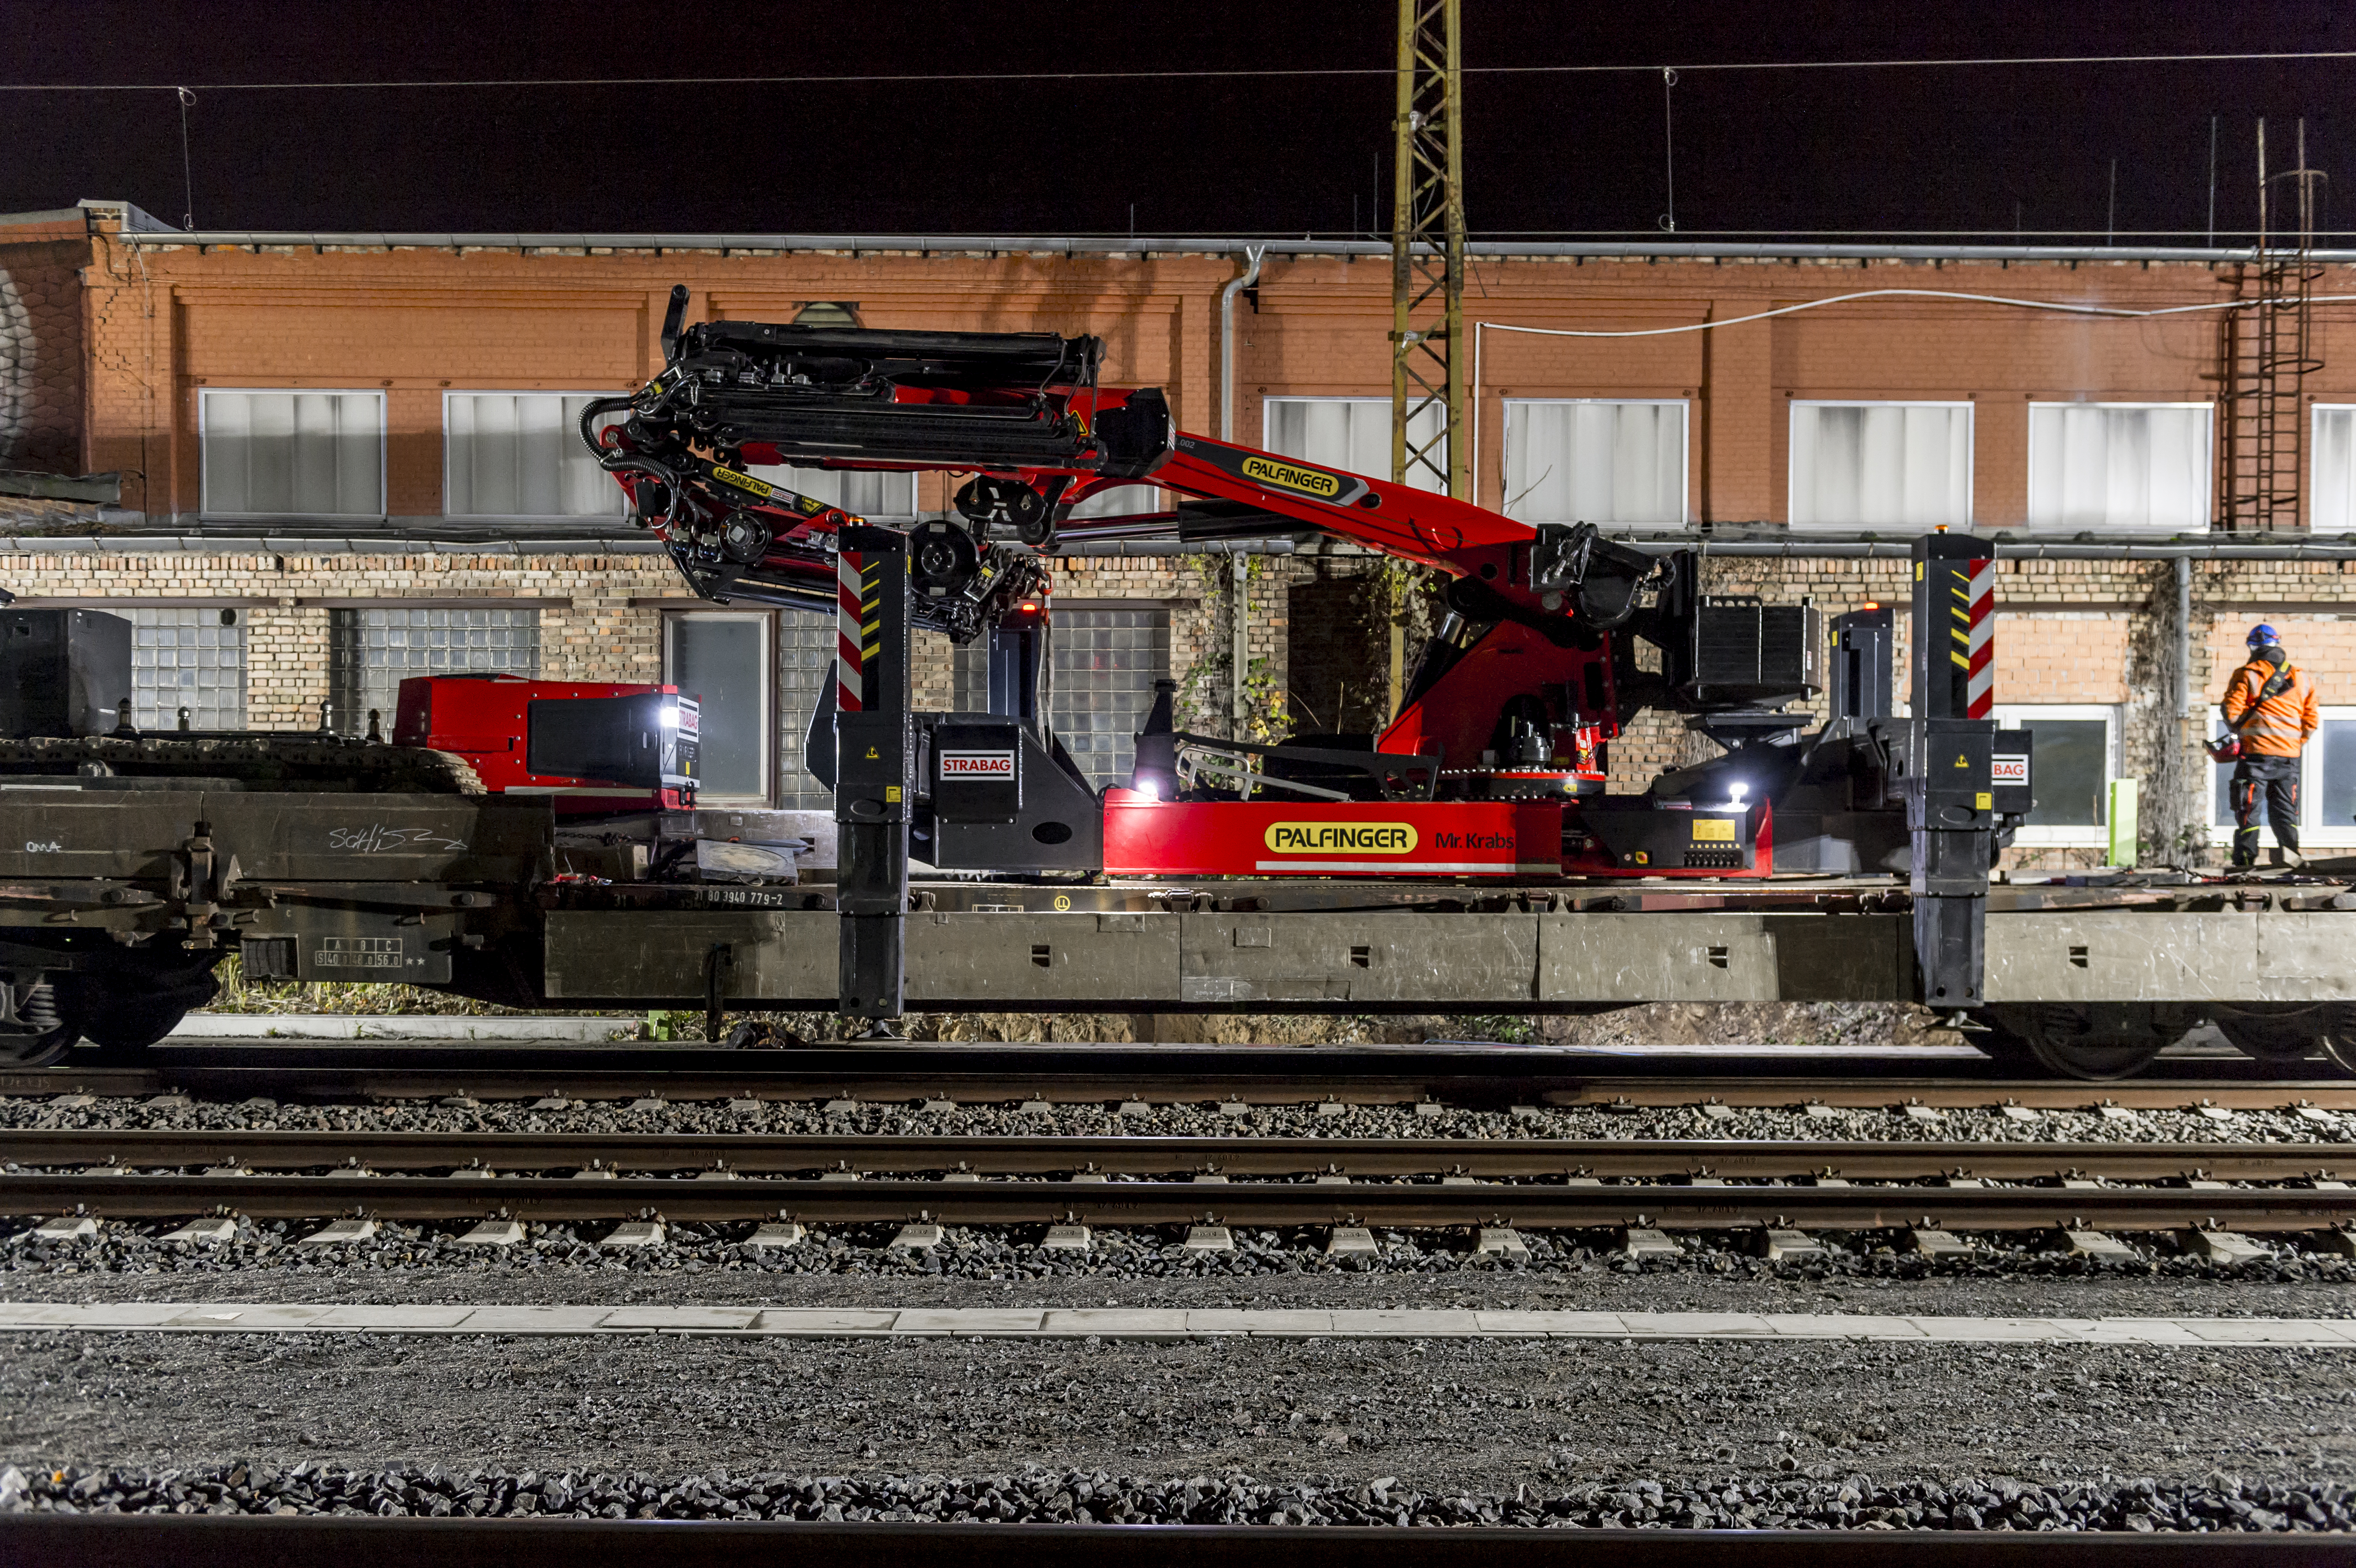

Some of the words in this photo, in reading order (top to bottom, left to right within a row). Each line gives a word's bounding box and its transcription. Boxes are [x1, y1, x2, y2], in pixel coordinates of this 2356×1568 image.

[717, 468, 770, 495] PALFINGER
[1248, 460, 1333, 492] PALFINGER
[679, 709, 697, 730] STRABAG
[943, 759, 1011, 771] STRABAG
[1992, 764, 2024, 775] BAG
[1275, 828, 1407, 848] PALFINGER
[1436, 832, 1462, 848] Mr.
[1466, 832, 1514, 849] Krabs
[723, 891, 745, 903] 3940
[751, 892, 783, 905] 779-2
[1057, 899, 1067, 908] LL
[335, 940, 341, 950] A
[386, 940, 391, 951] C
[318, 953, 324, 964] S
[378, 954, 398, 966] 56.0
